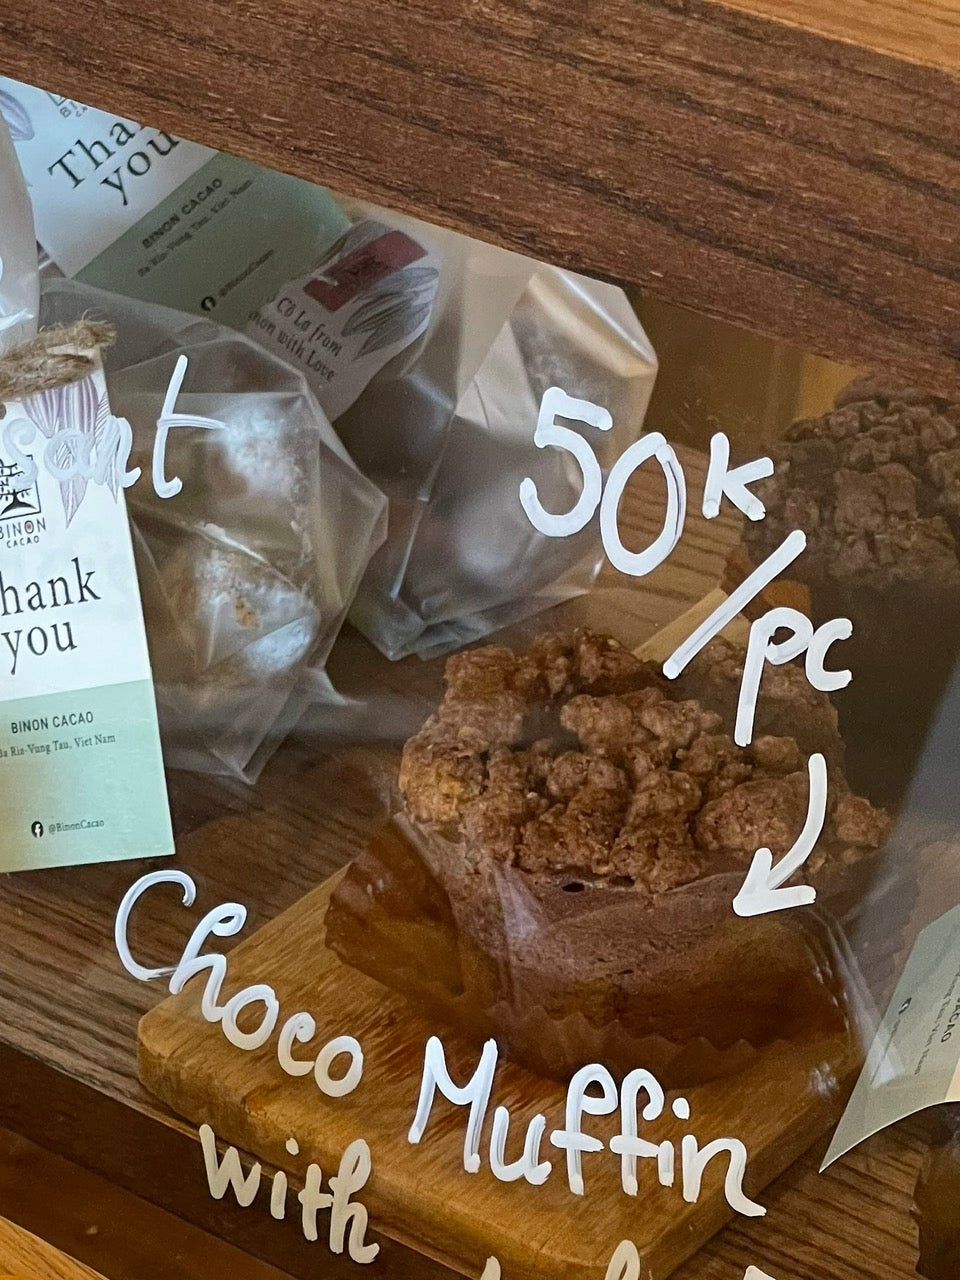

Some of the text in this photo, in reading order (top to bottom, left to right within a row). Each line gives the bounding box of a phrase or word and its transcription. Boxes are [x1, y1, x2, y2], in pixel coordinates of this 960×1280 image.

[47, 121, 145, 189] Tha
[100, 130, 180, 206] you
[181, 178, 223, 215] CACAO
[6, 535, 41, 549] CACAO
[1, 620, 78, 676] you
[10, 741, 52, 758] Ria-Vung
[74, 735, 94, 749] Viet
[95, 732, 117, 746] Nam
[11, 711, 95, 734] BINON CACAO
[48, 818, 106, 835] @BinonCacao
[115, 869, 768, 1218] Choco Muffin
[198, 1123, 380, 1265] with
